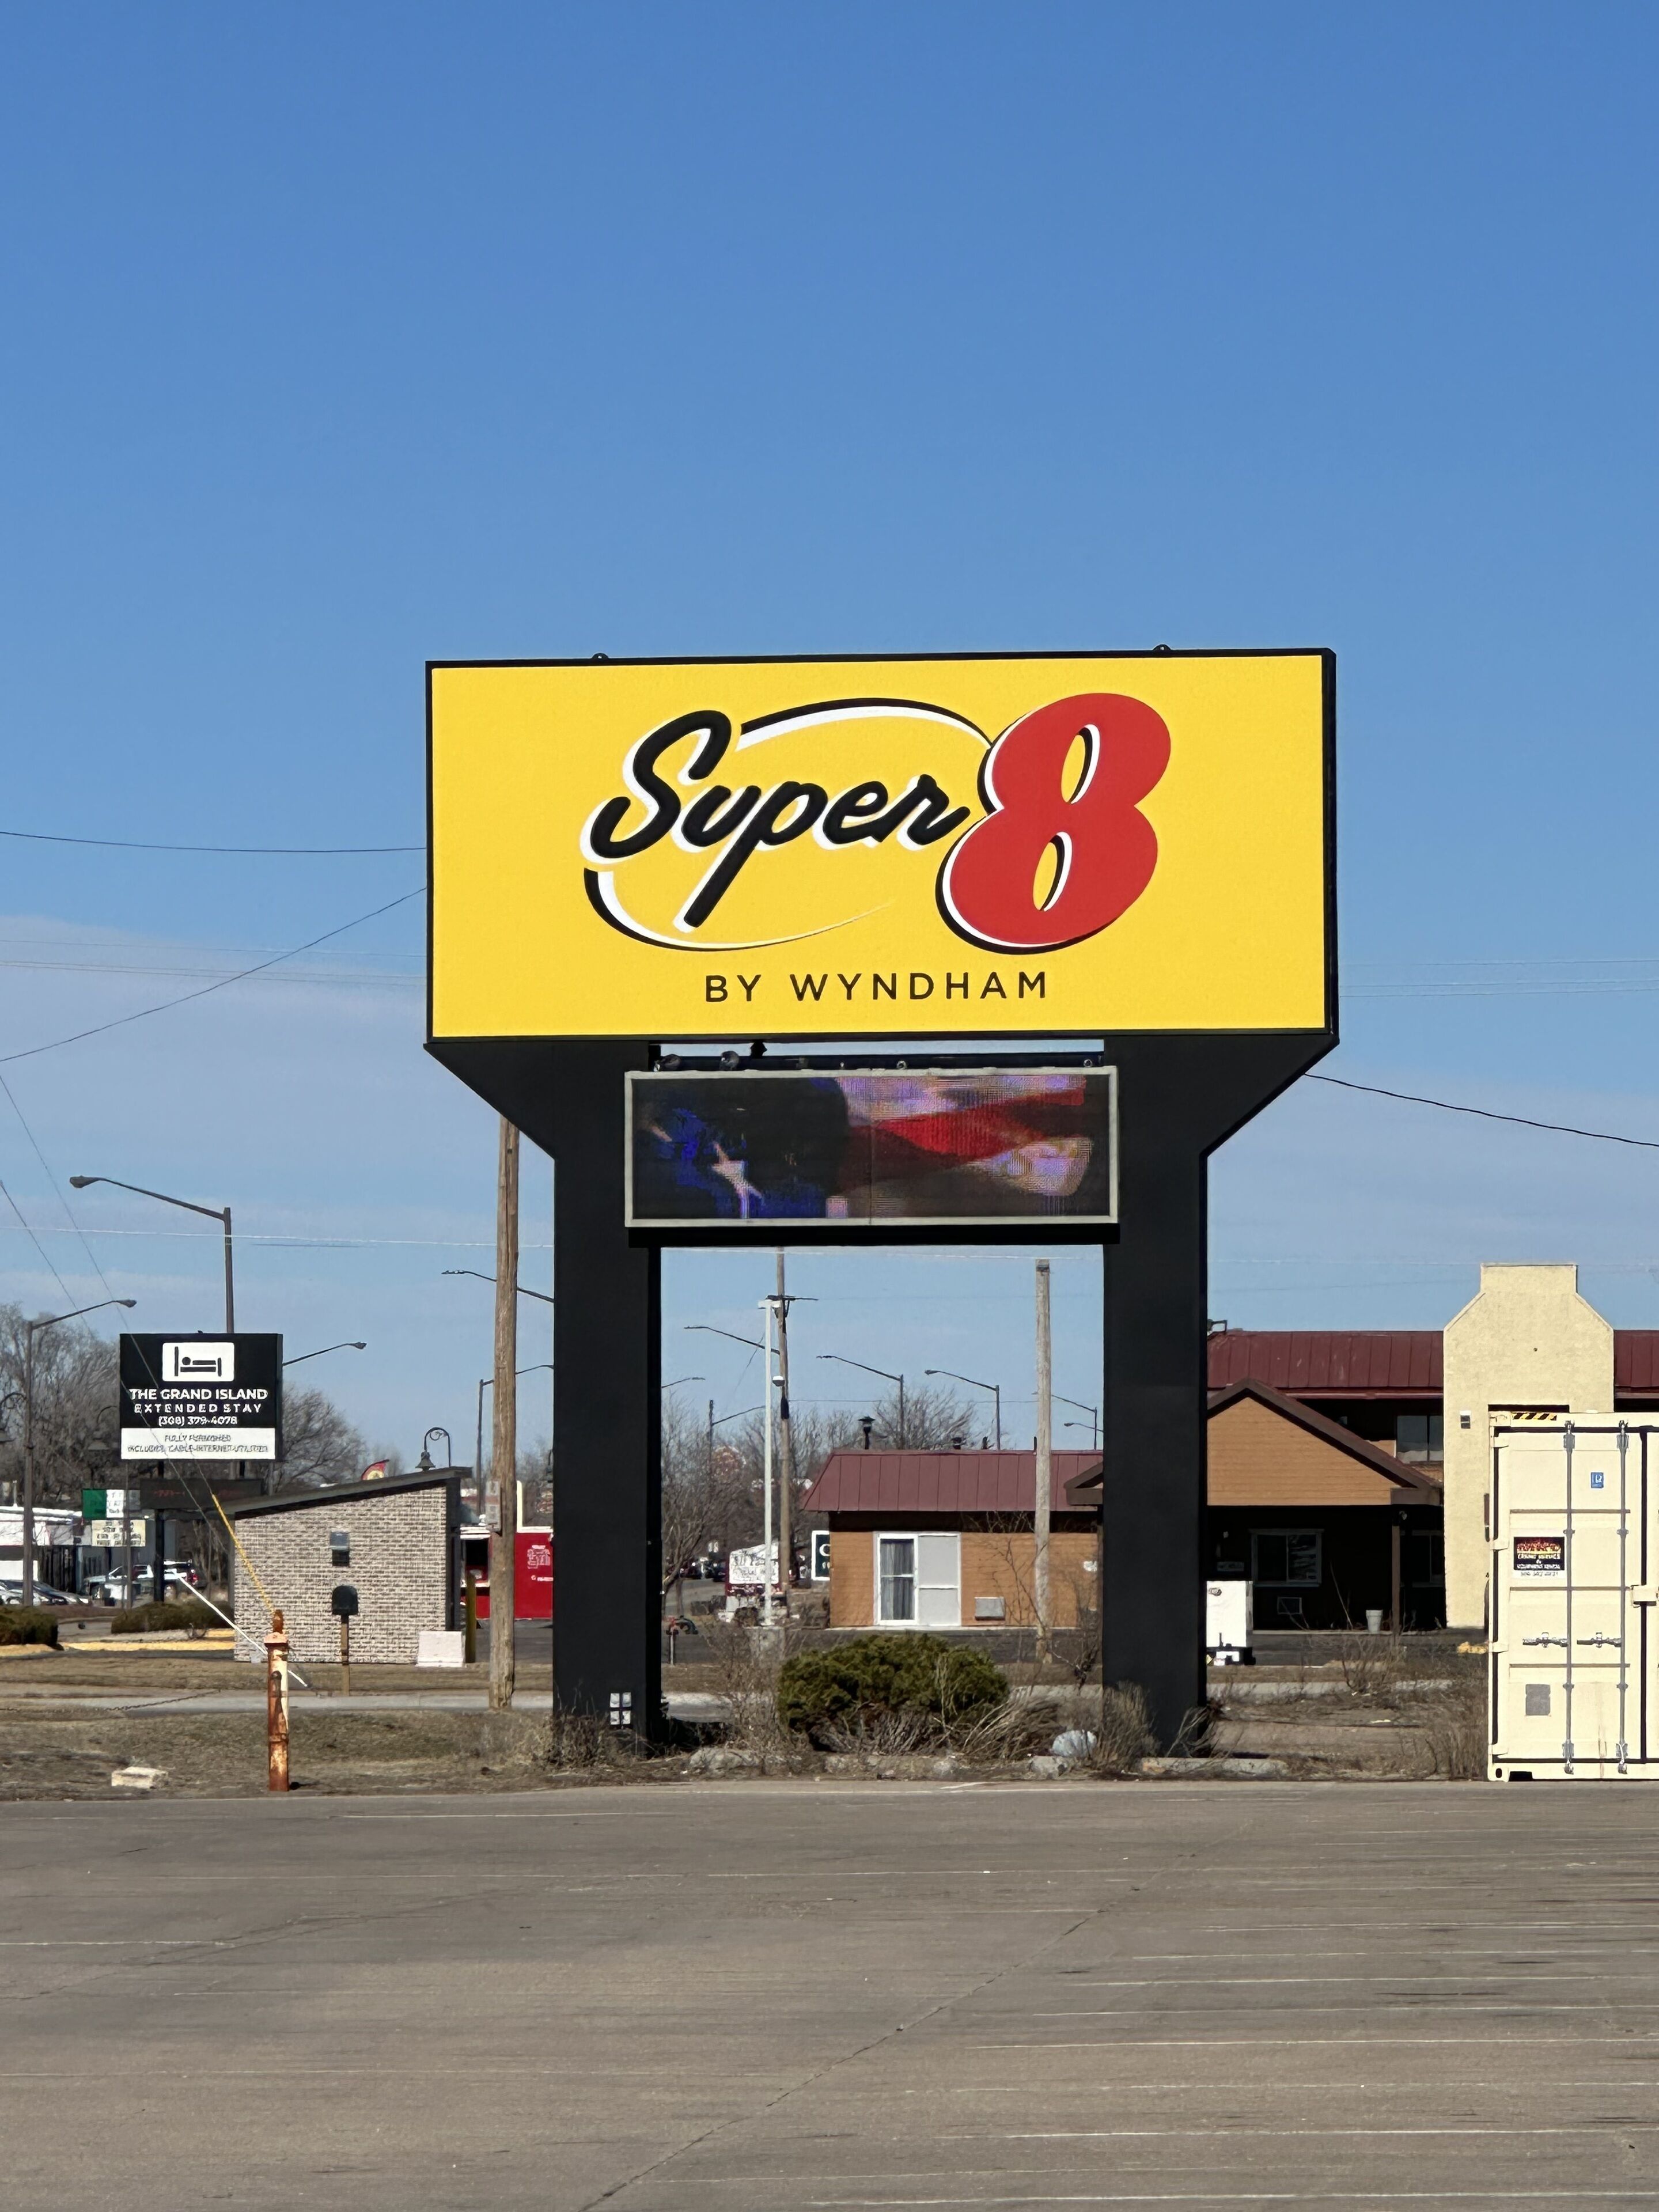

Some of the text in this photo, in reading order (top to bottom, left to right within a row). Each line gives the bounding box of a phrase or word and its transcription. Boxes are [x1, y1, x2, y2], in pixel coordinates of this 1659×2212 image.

[578, 692, 1172, 956] Super 8
[704, 971, 1047, 1003] BY WYNDHAM
[128, 1388, 268, 1400] THE GRAND ISLAND
[134, 1403, 262, 1413] EXTENDED STAY
